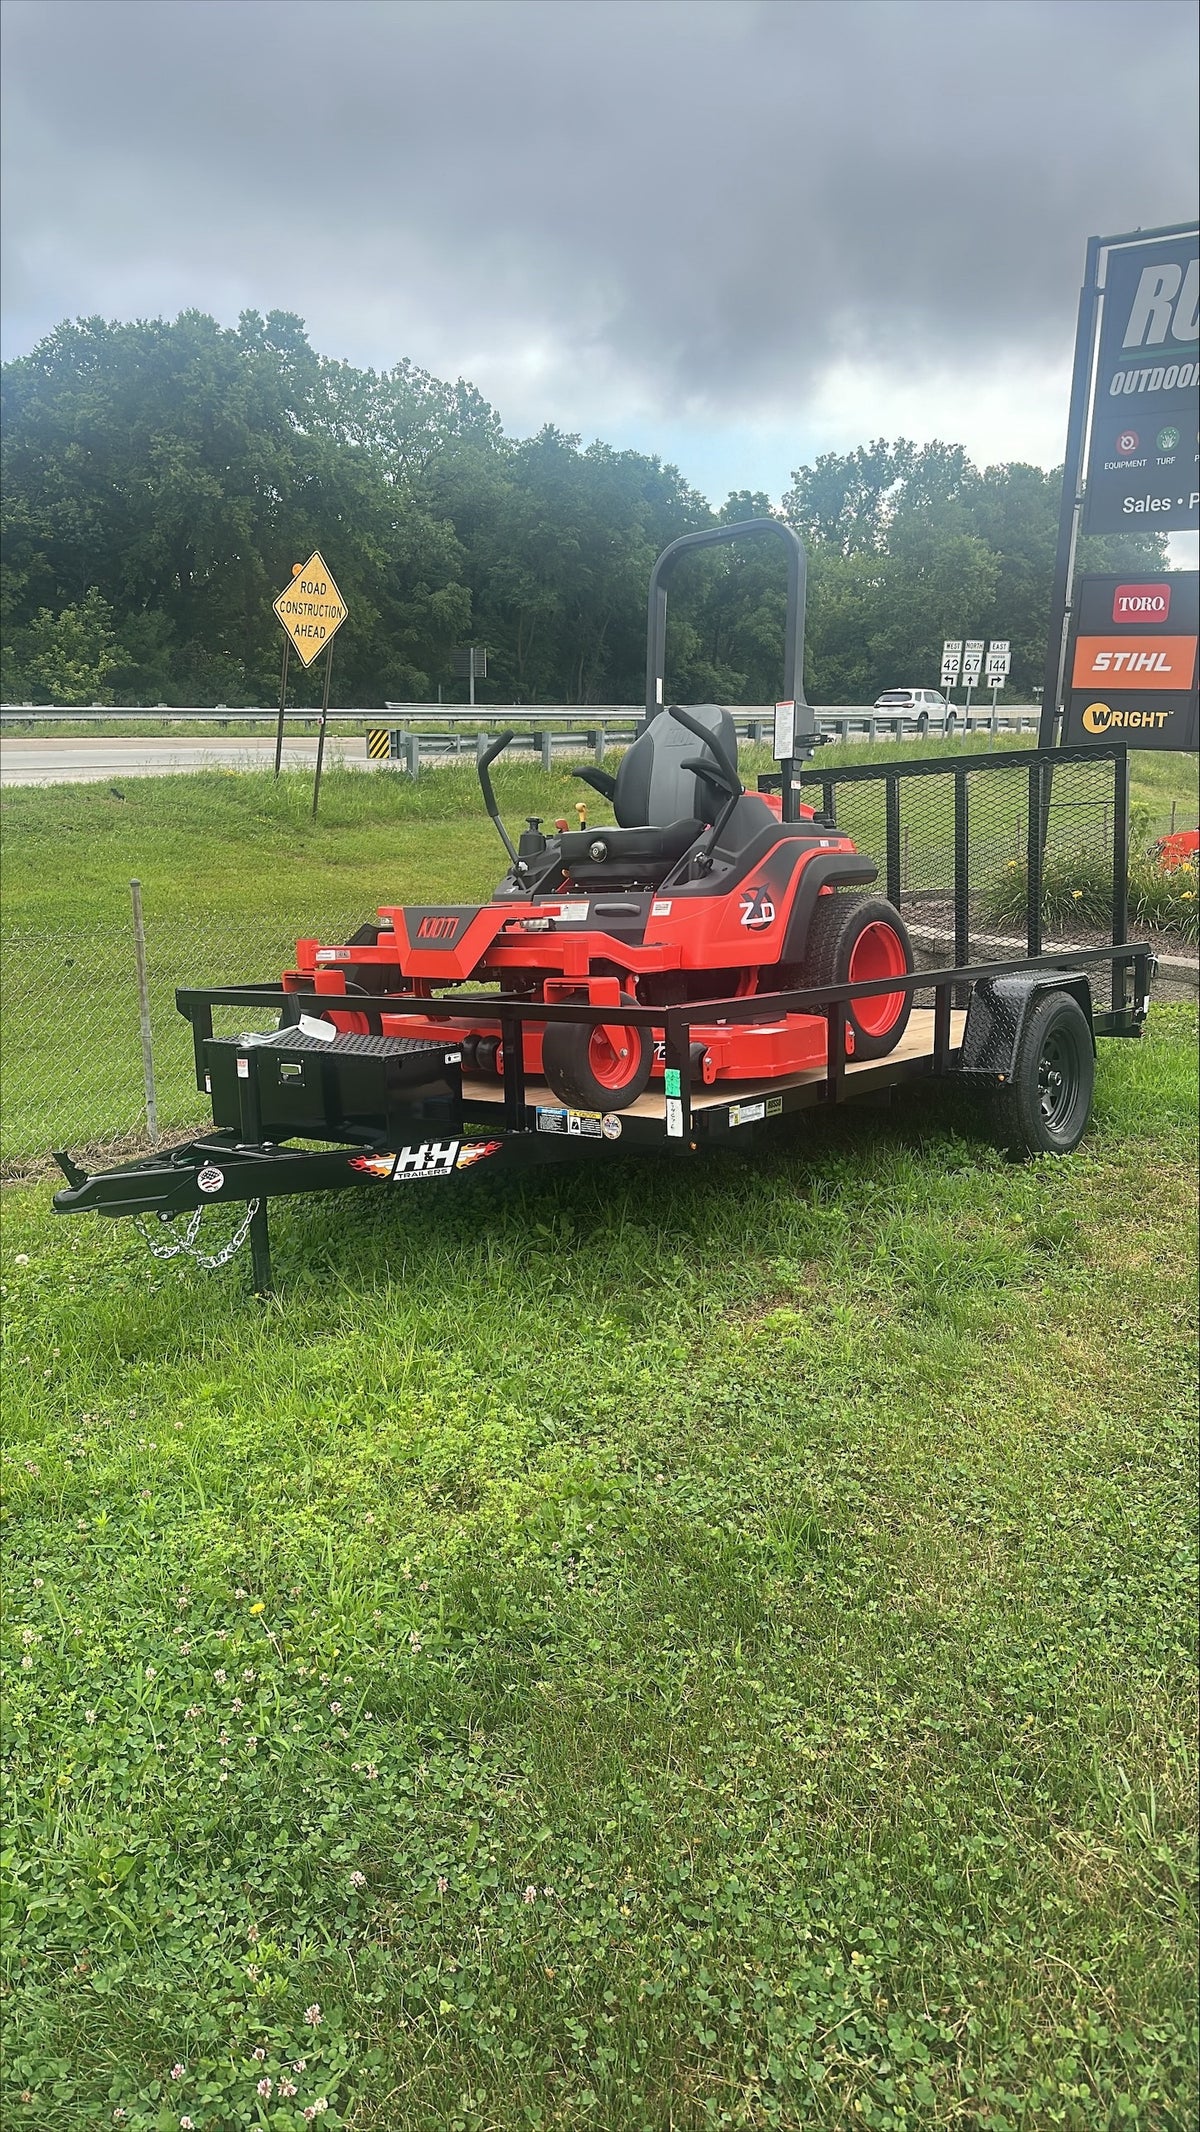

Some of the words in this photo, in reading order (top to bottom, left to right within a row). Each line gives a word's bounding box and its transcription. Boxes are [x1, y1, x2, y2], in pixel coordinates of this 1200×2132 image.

[1104, 458, 1147, 470] EQUIPMENT
[1155, 456, 1176, 466] TURF
[1122, 494, 1171, 513] Sales
[300, 581, 327, 595] ROAD
[280, 600, 342, 618] CONSTRUCTION
[1118, 596, 1165, 612] TORO
[293, 624, 326, 639] AHEAD
[943, 659, 959, 671] 42
[964, 659, 980, 671] 67
[989, 660, 1006, 672] 144
[1092, 652, 1172, 672] STIHL
[1092, 711, 1169, 728] WRIGHT
[396, 1141, 460, 1172] H&H
[397, 1168, 448, 1179] TRAILERS
